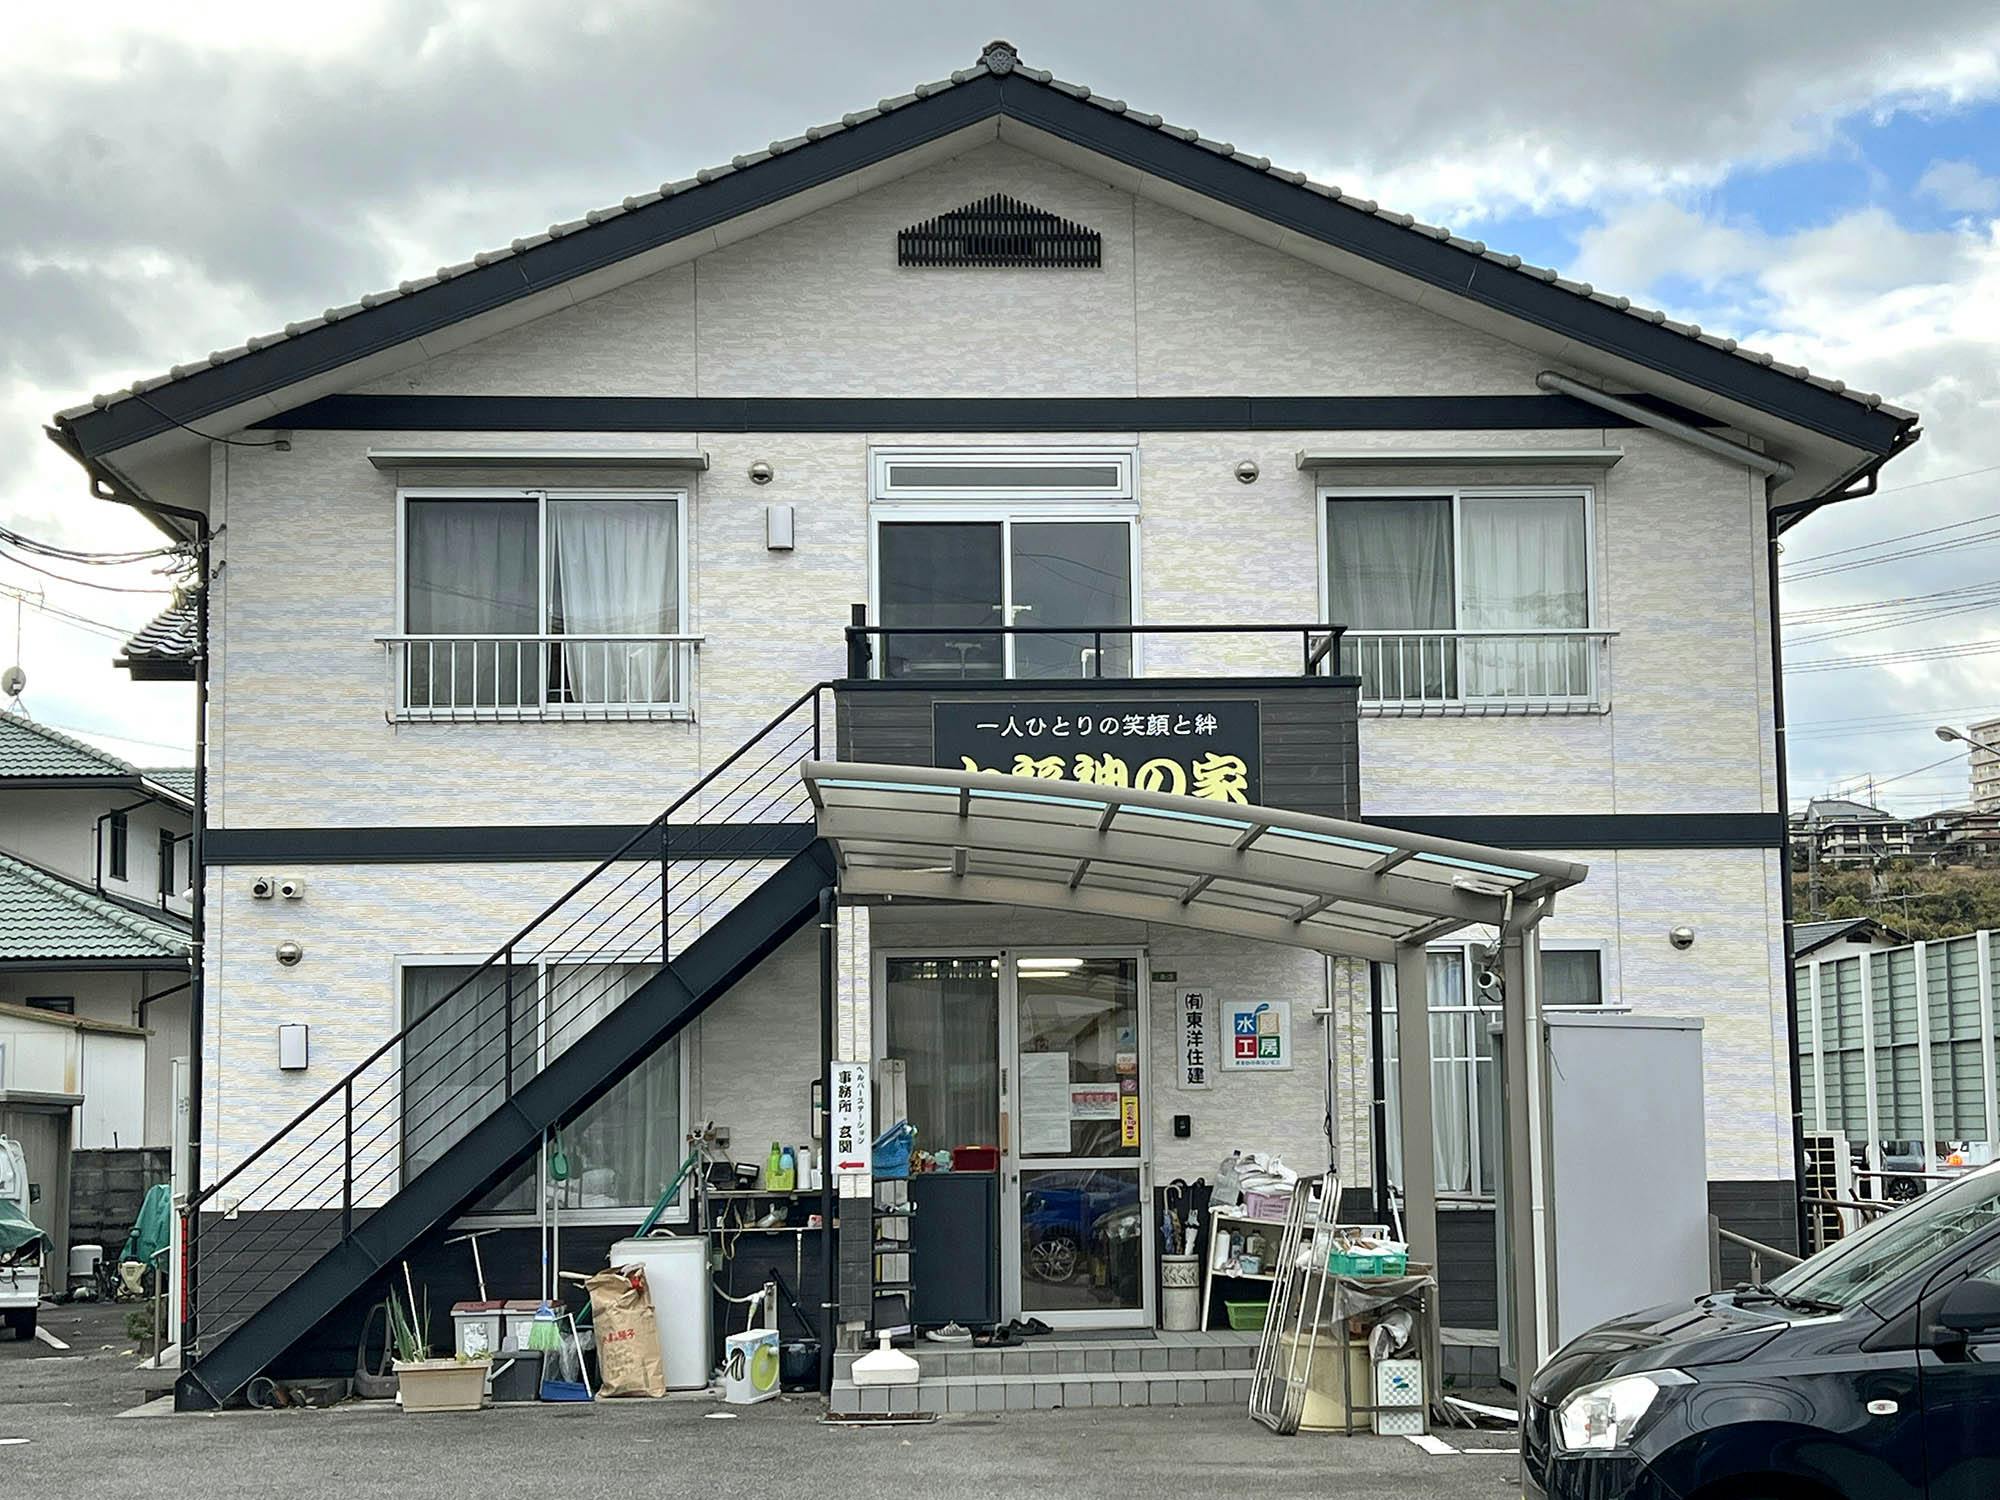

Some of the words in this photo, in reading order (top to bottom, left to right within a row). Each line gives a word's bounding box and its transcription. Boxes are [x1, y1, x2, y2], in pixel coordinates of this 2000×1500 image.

[976, 713, 1218, 737] 一人ひとりの笑顔と絆
[838, 1070, 852, 1153] 事務所・玄関
